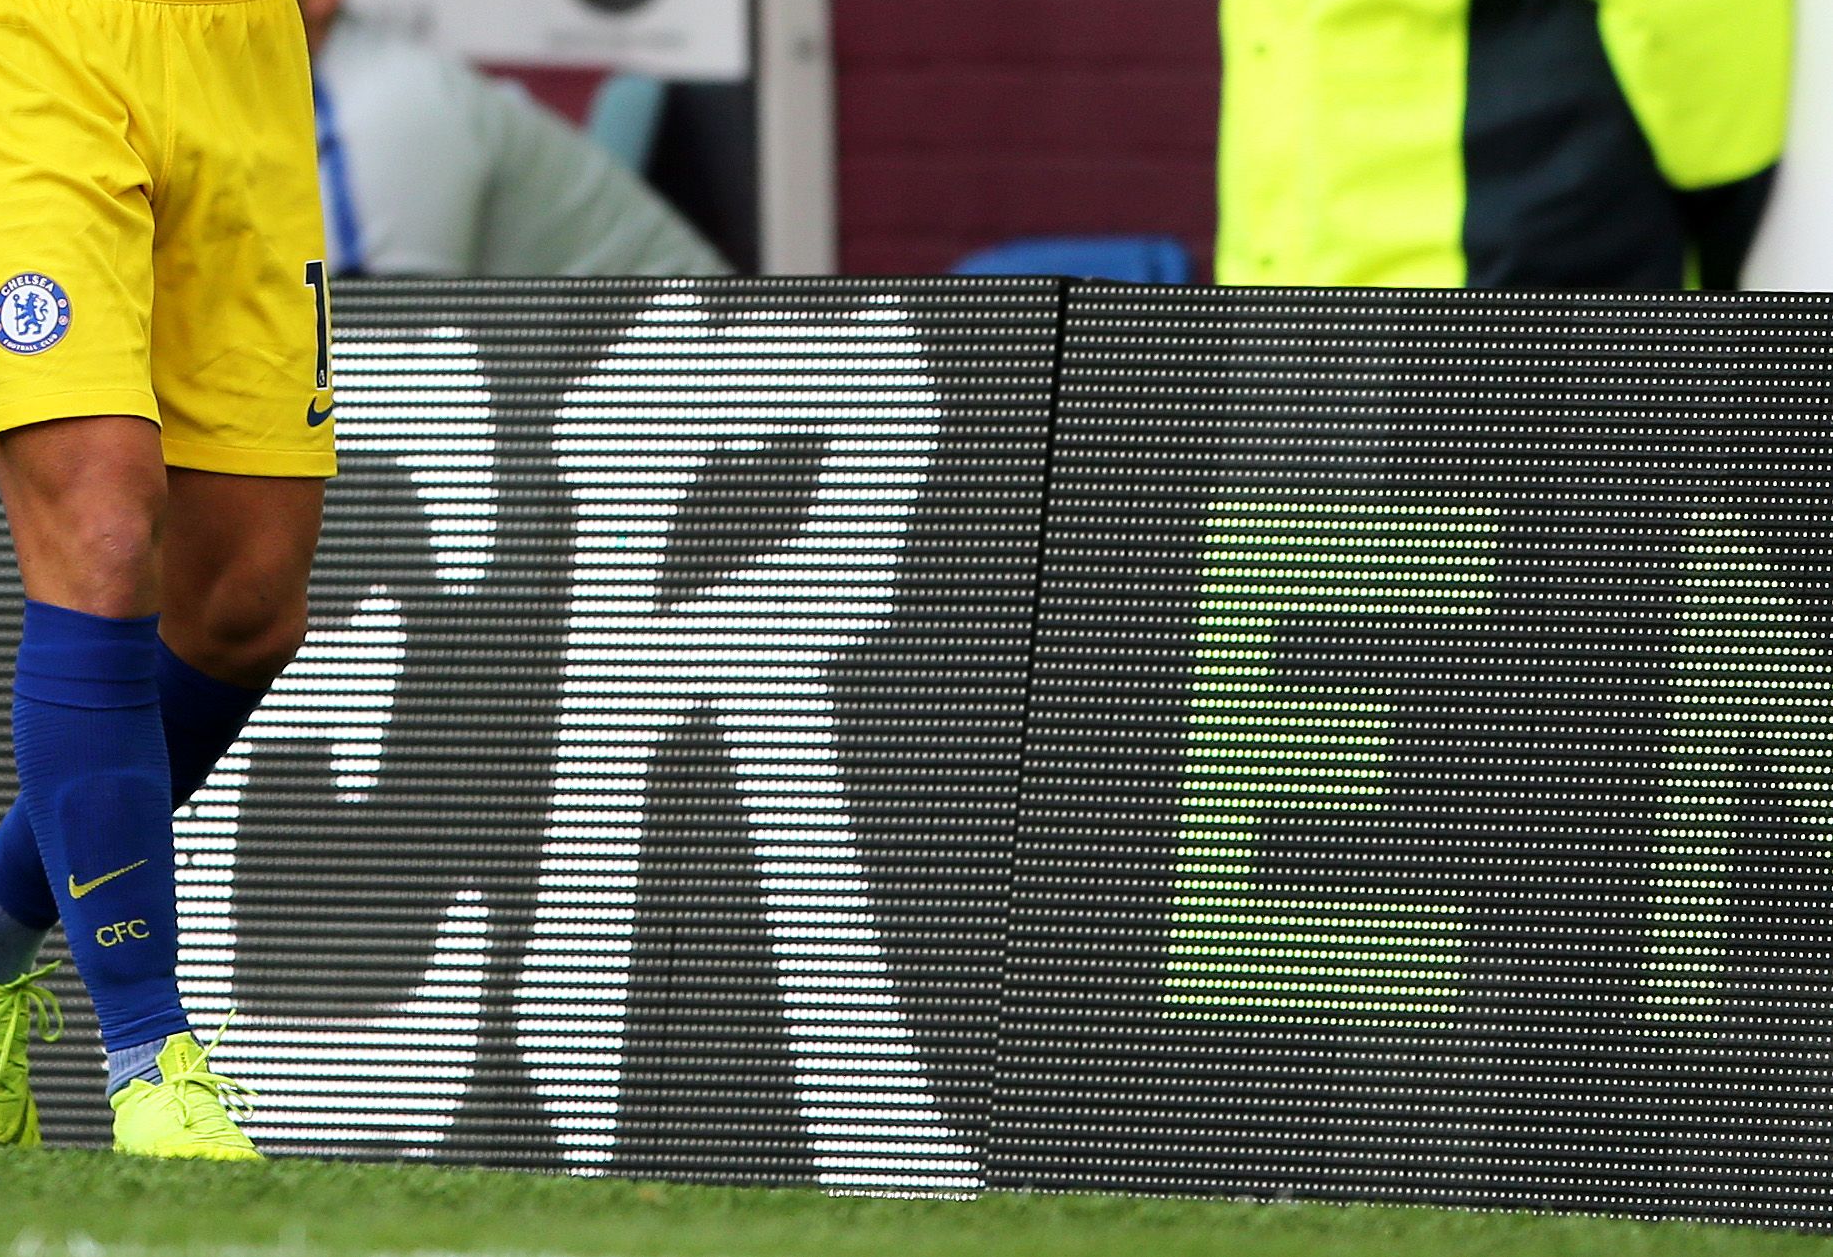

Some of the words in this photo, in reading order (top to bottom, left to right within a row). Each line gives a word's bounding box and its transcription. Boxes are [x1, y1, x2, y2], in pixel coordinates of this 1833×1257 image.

[1, 275, 55, 297] CHELSEA
[2, 339, 38, 352] FOOTBALL
[95, 918, 151, 948] CFC
